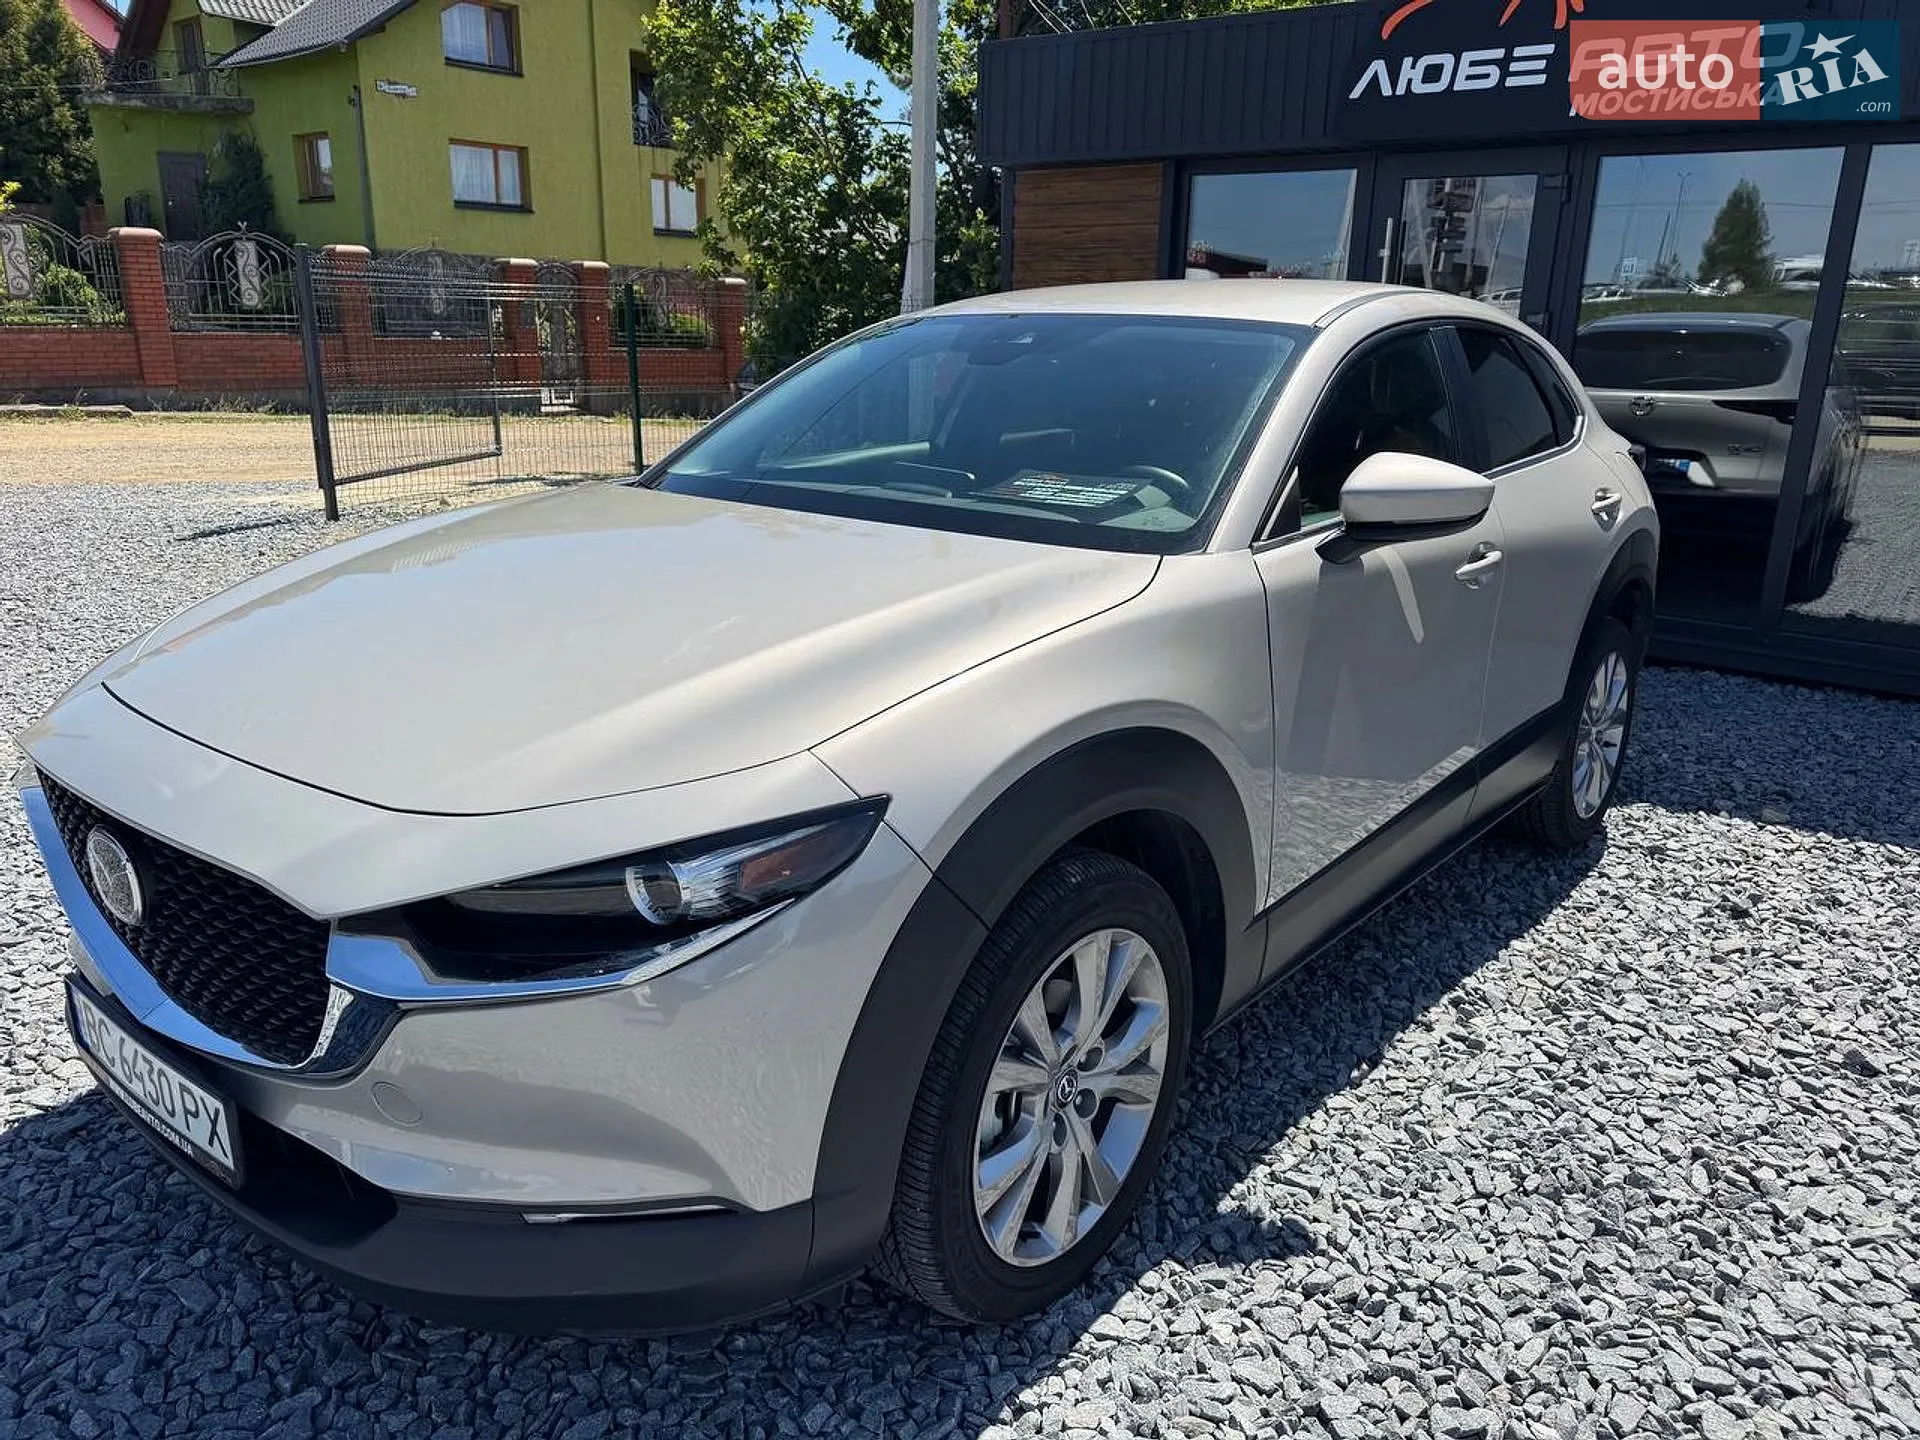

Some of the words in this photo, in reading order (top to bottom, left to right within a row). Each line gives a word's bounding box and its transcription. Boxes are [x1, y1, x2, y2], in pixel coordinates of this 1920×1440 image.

[1349, 43, 1555, 99] ЛЮБЕ
[1568, 22, 1806, 82] АВТО
[1569, 80, 1787, 117] МОСТИСЬКА
[82, 1001, 115, 1068] BC
[119, 1037, 176, 1118] 6430
[178, 1083, 229, 1160] PX
